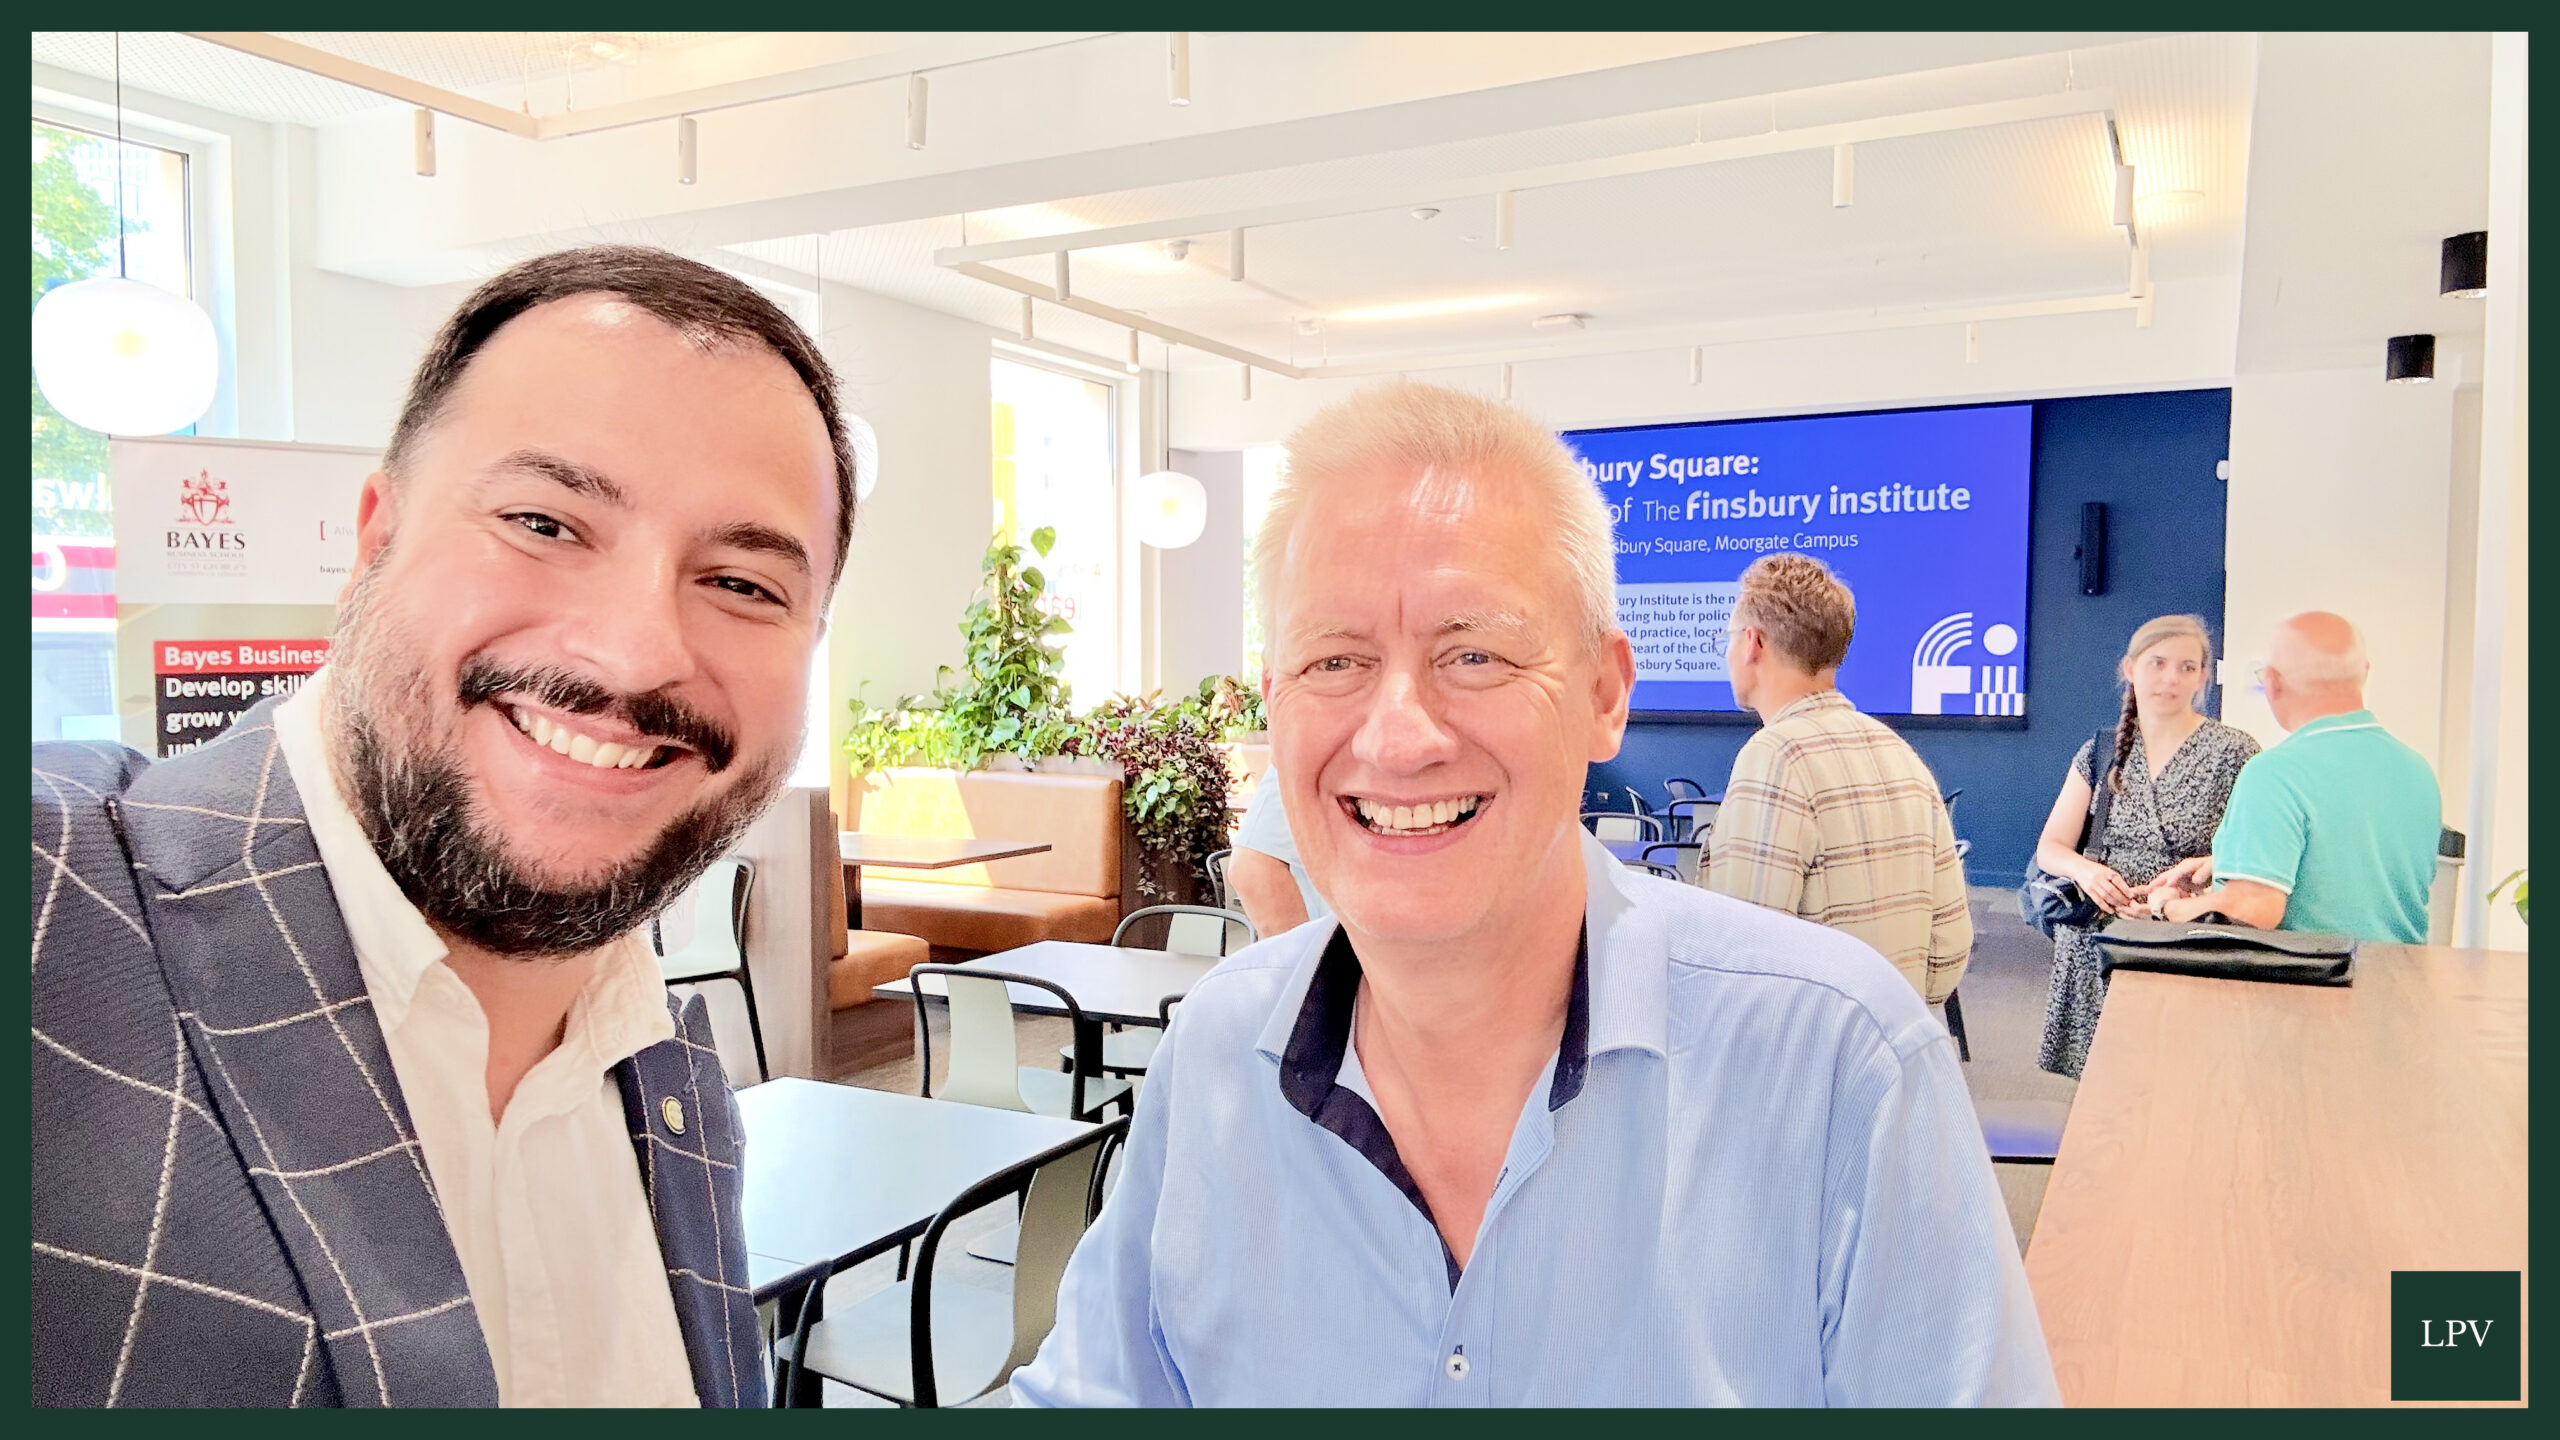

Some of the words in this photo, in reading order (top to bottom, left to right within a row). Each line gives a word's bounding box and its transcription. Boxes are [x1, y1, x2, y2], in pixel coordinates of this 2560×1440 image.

[1581, 456, 1643, 488] bury
[1649, 453, 1760, 485] Square:
[1609, 496, 1634, 523] of
[1642, 500, 1680, 521] The
[1686, 489, 1821, 523] Finsbury
[1829, 483, 1970, 515] institute
[166, 532, 245, 550] BAYES
[1614, 538, 1652, 556] sbury
[1655, 537, 1711, 555] Square,
[1715, 534, 1789, 552] Moorgate
[1793, 533, 1859, 550] Campus
[1640, 594, 1689, 606] Institute
[1692, 593, 1702, 605] is
[1705, 593, 1725, 605] the
[1653, 610, 1676, 621] hub
[1679, 610, 1695, 621] for
[1624, 627, 1637, 638] nd
[1640, 626, 1691, 640] practice,
[165, 646, 232, 670] Bayes
[1663, 642, 1675, 654] of
[1677, 642, 1697, 654] the
[1675, 659, 1721, 672] Square.
[165, 676, 255, 700] Develop
[261, 671, 307, 697] skill
[166, 711, 223, 733] grow
